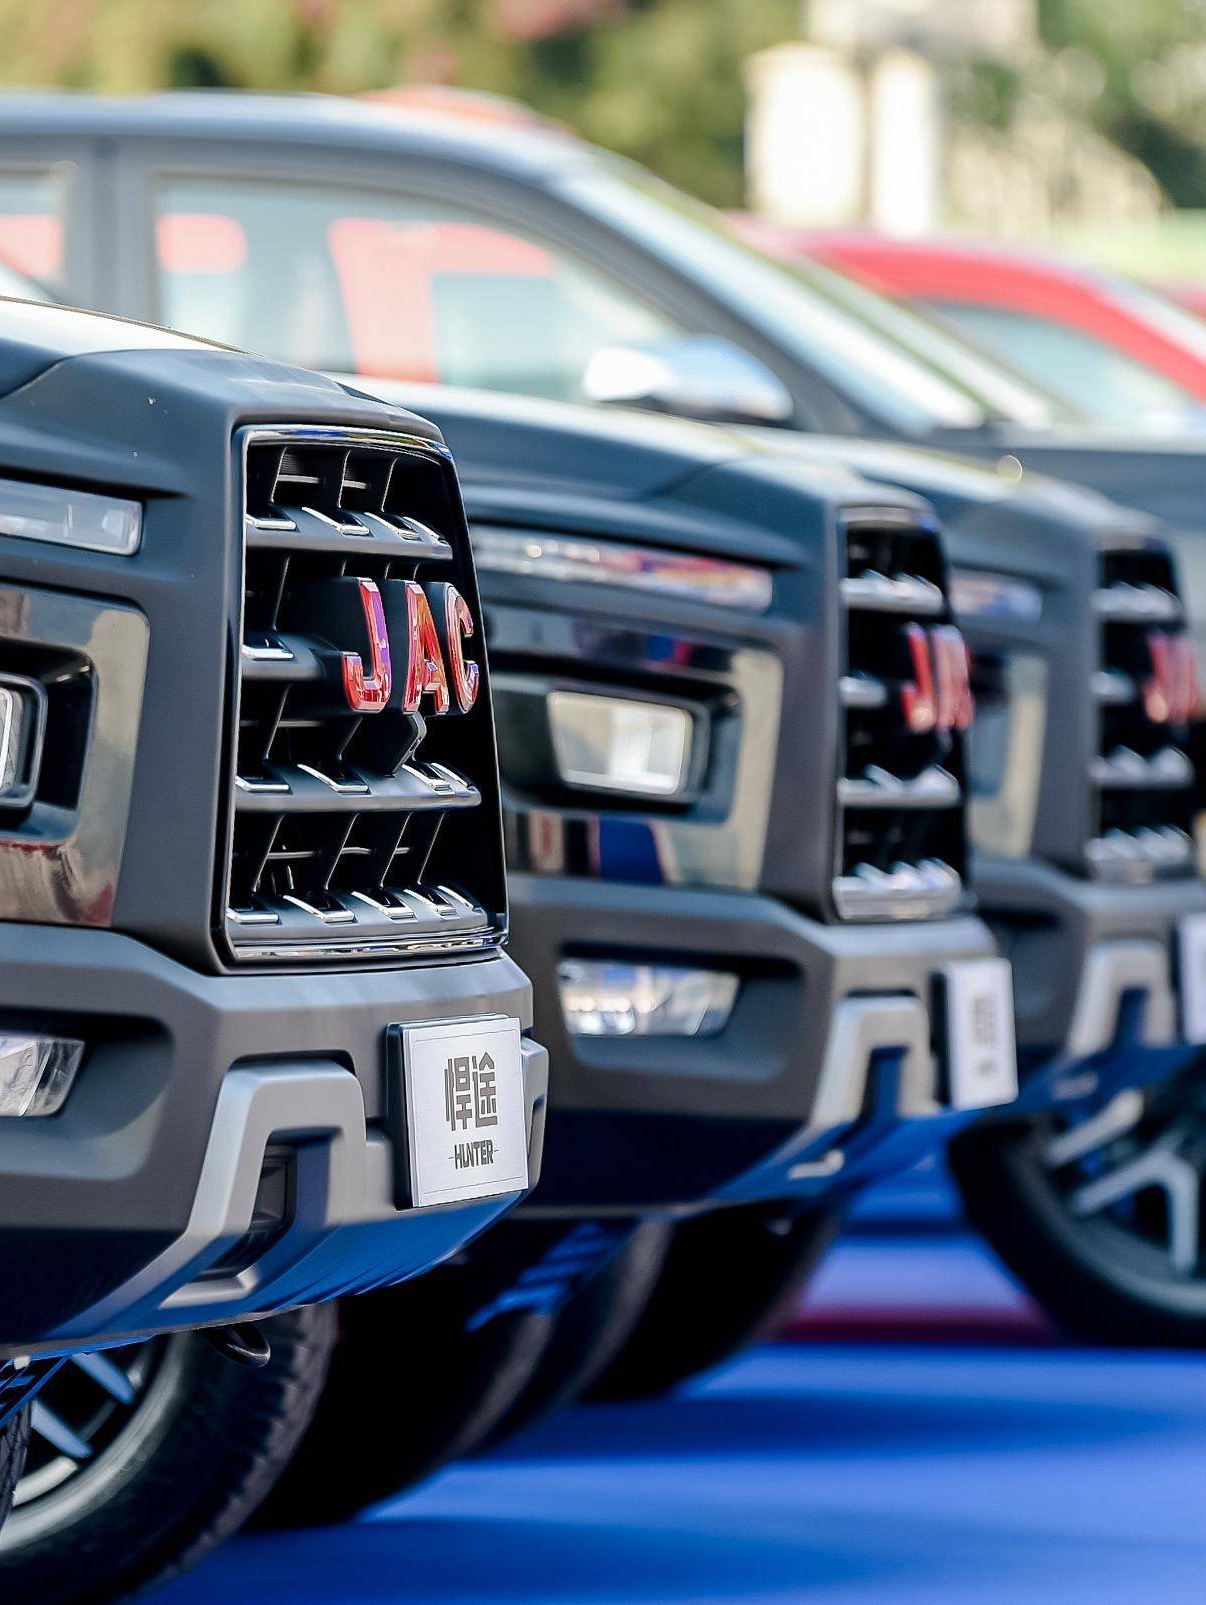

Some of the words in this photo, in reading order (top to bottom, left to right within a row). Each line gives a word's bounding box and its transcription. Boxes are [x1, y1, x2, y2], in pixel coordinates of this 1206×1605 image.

[344, 580, 480, 714] JAC
[901, 622, 974, 732] JA
[444, 1051, 498, 1131] 悍途
[454, 1139, 495, 1169] HUNTER
